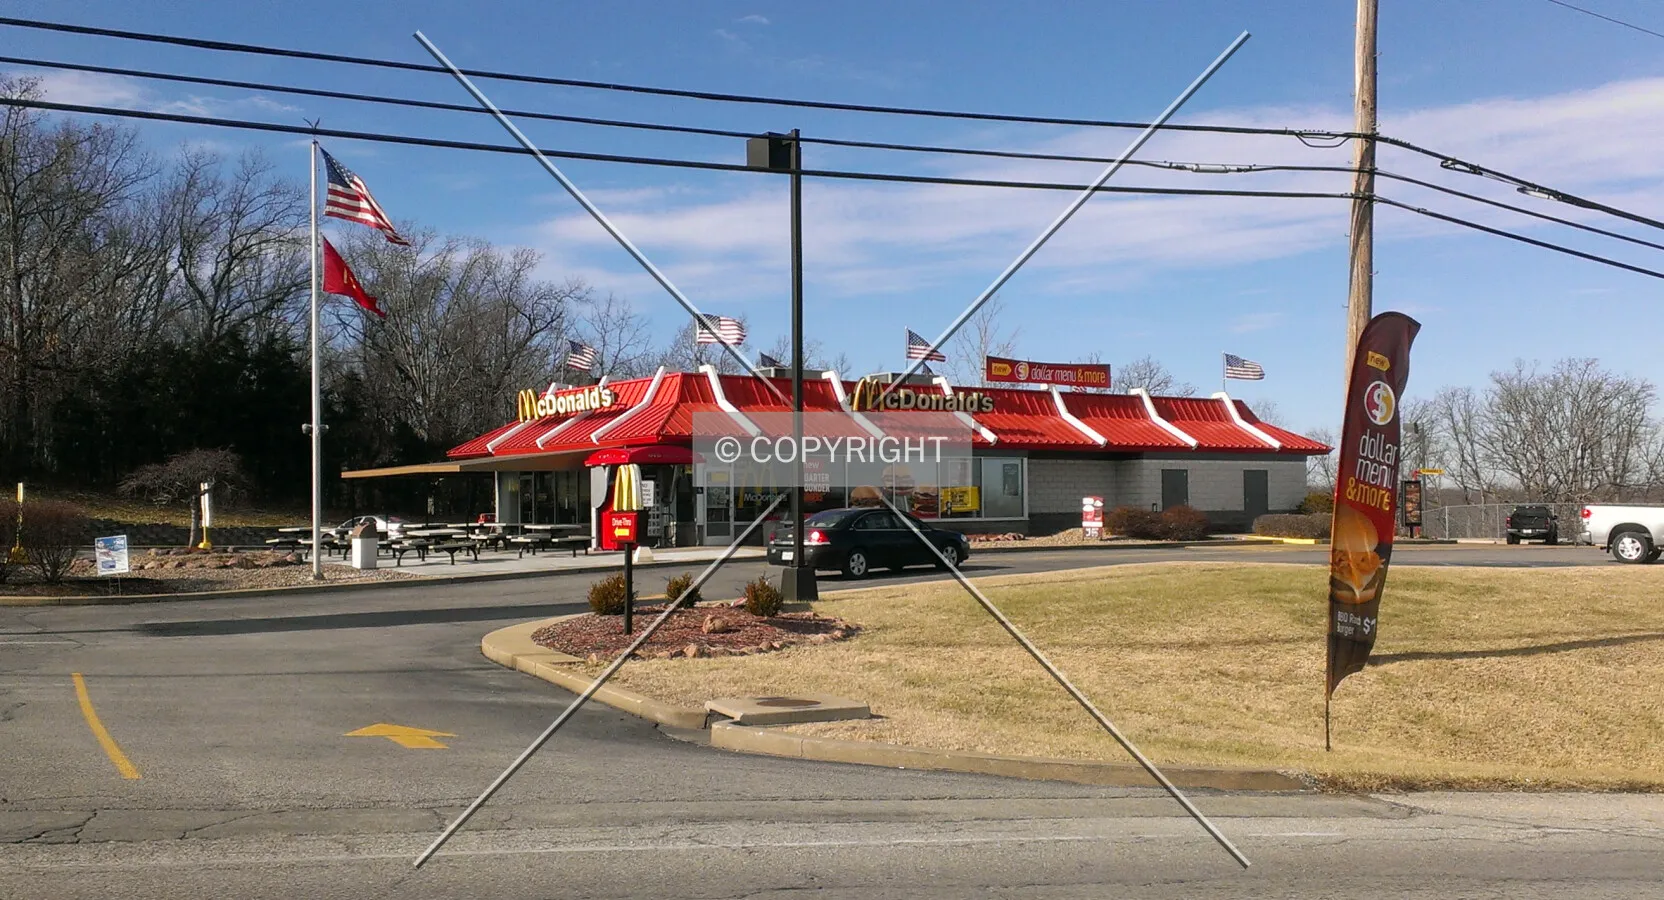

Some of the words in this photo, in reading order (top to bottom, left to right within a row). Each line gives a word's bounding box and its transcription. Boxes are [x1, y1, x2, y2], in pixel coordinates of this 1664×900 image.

[1370, 354, 1385, 367] new
[1031, 365, 1053, 380] dollar
[1055, 369, 1076, 382] menu
[518, 386, 612, 422] McDonald's
[852, 377, 994, 412] McDonald's
[1359, 428, 1398, 466] dollar
[804, 473, 830, 482] UARTER
[1355, 458, 1395, 489] menu
[804, 483, 830, 492] OUNDER
